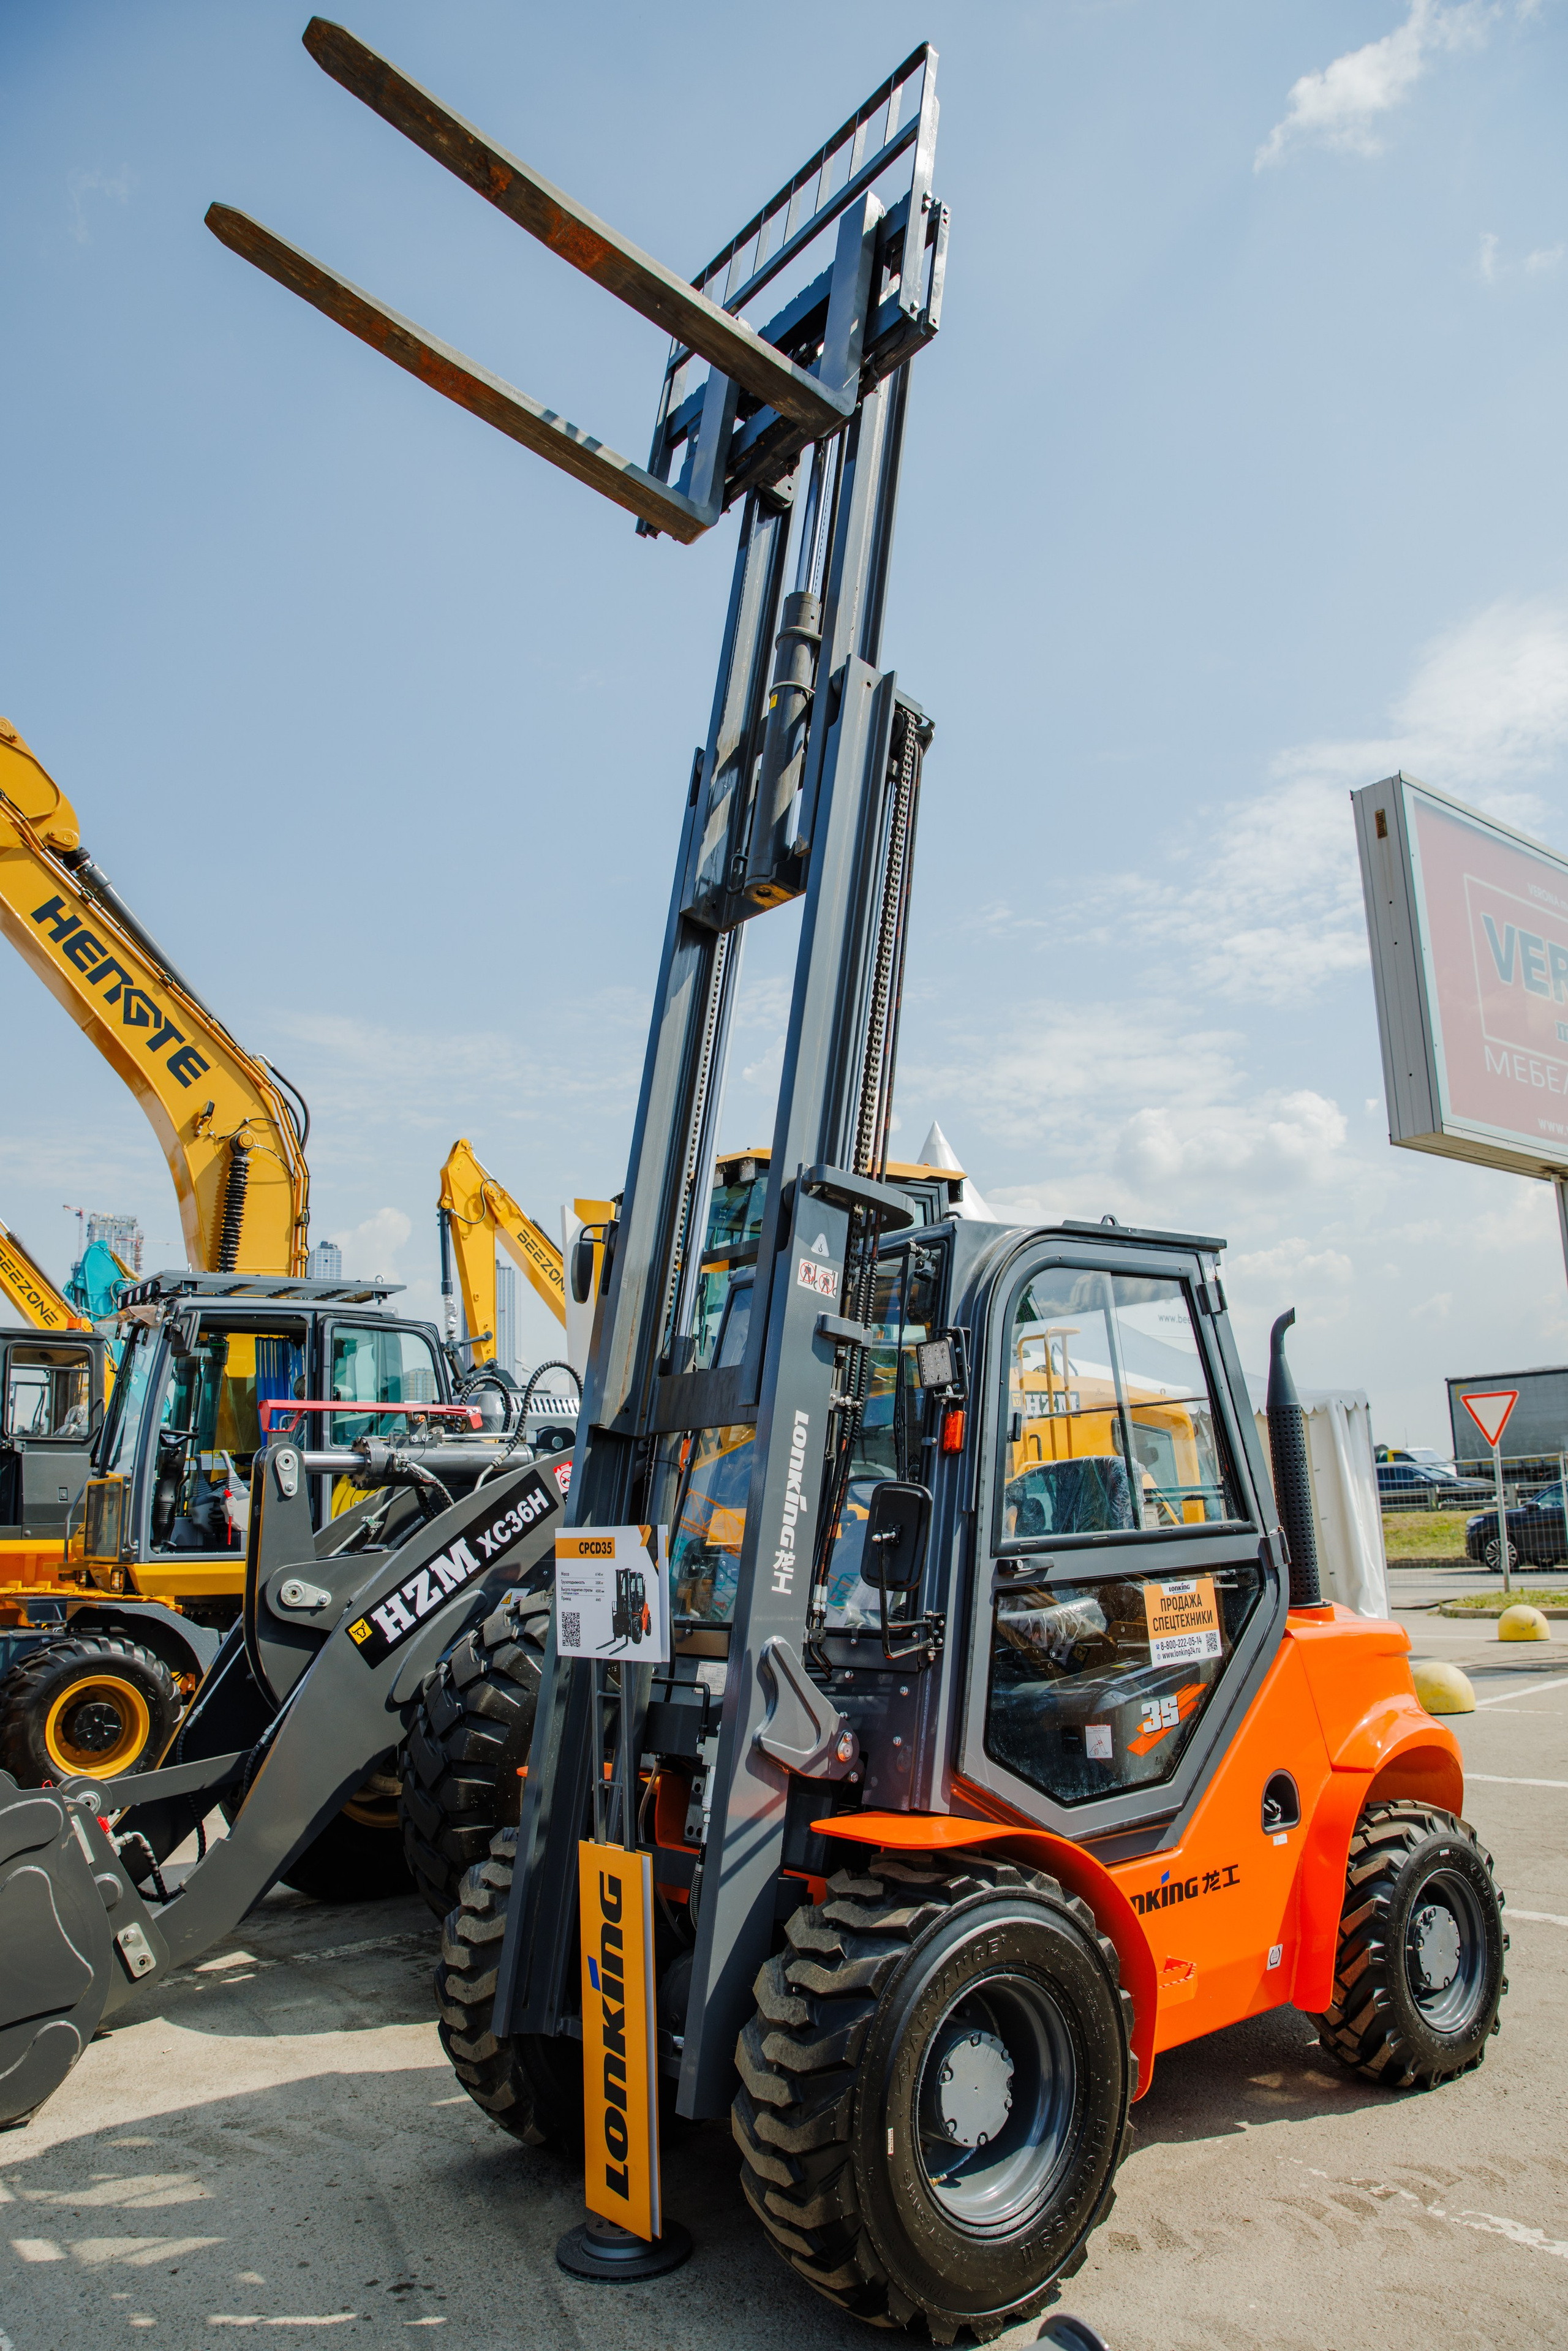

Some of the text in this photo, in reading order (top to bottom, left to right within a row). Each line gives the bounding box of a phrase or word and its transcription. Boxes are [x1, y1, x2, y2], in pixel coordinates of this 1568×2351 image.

[1537, 1118, 1568, 1136] www.
[517, 1229, 565, 1296] BEEZON
[579, 1541, 612, 1554] CPCD35
[371, 1537, 481, 1643] HZM
[1160, 1593, 1202, 1612] ПРОДАЖА
[1153, 1610, 1213, 1632] СПЕЦТЕХНИКИ
[1161, 1636, 1202, 1651] 8-800-222-05-14
[1162, 1647, 1201, 1659] www.lonking24.ru
[1141, 1696, 1180, 1734] 35
[1202, 1863, 1240, 1894] 龙工
